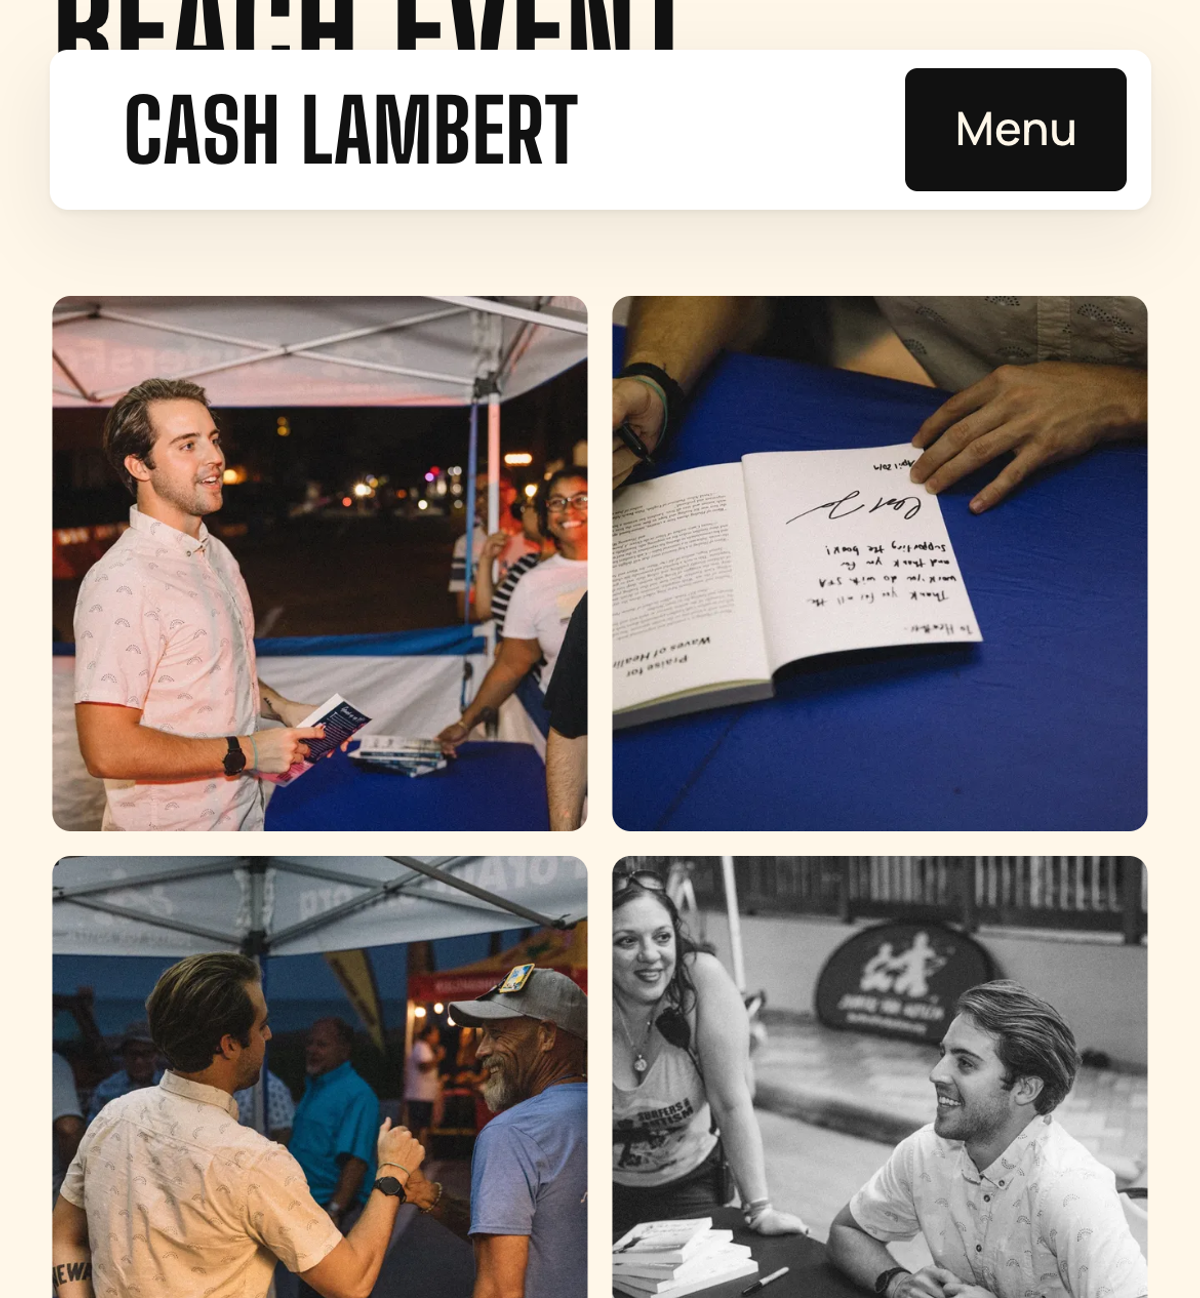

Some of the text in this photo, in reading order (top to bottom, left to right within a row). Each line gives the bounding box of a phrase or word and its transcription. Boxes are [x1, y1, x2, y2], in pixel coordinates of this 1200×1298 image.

[126, 93, 579, 165] CASH LAMBERT
[957, 111, 1076, 147] Menu
[653, 645, 667, 658] of
[670, 636, 711, 651] Waves
[626, 654, 688, 678] Praise for
